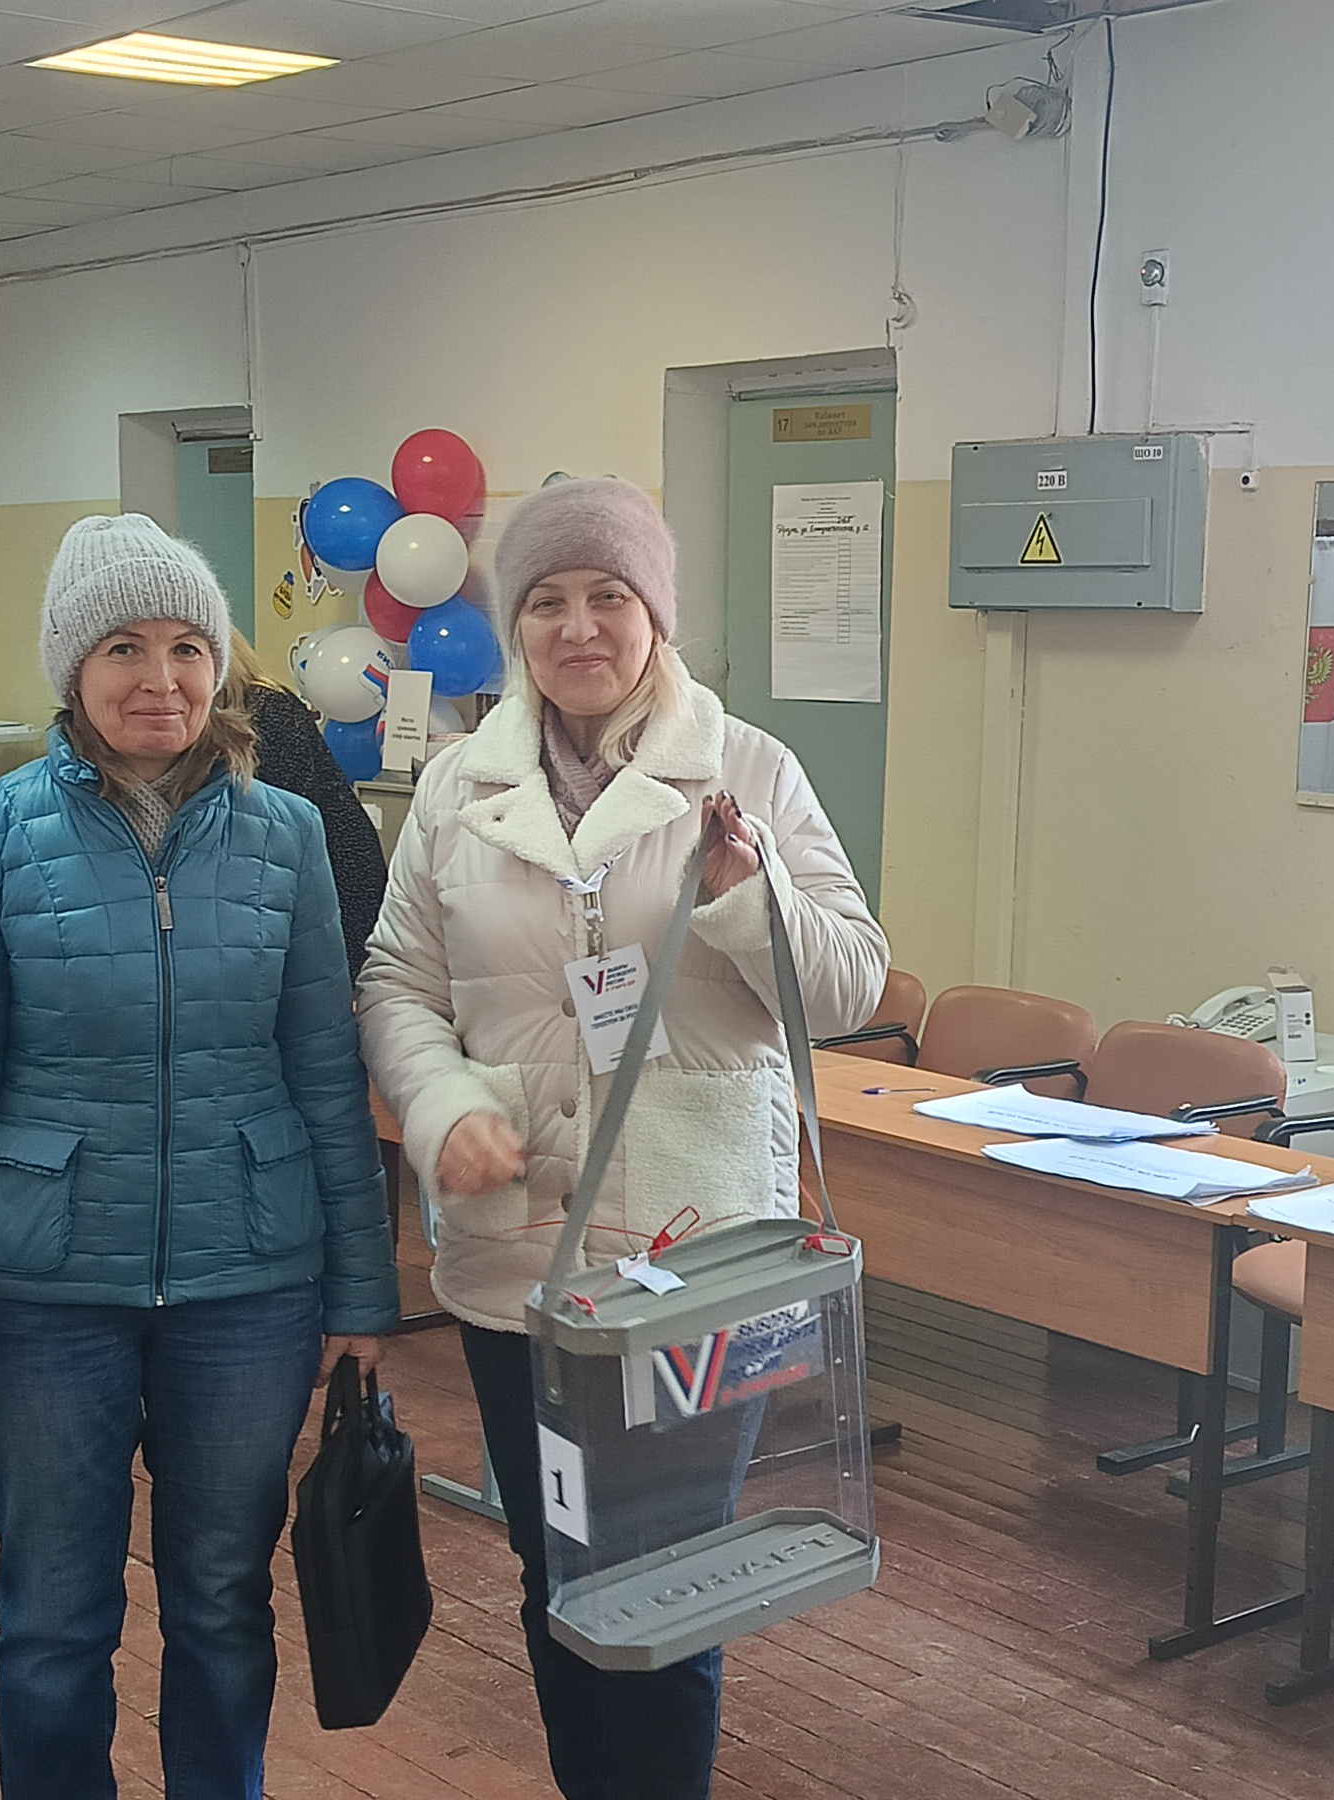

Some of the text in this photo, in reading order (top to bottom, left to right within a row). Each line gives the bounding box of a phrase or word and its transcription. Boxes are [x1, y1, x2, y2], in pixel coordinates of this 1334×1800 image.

[777, 418, 790, 432] 17
[1134, 449, 1162, 458] ЩО 10
[1038, 474, 1066, 487] 220 В
[550, 1467, 571, 1511] 1
